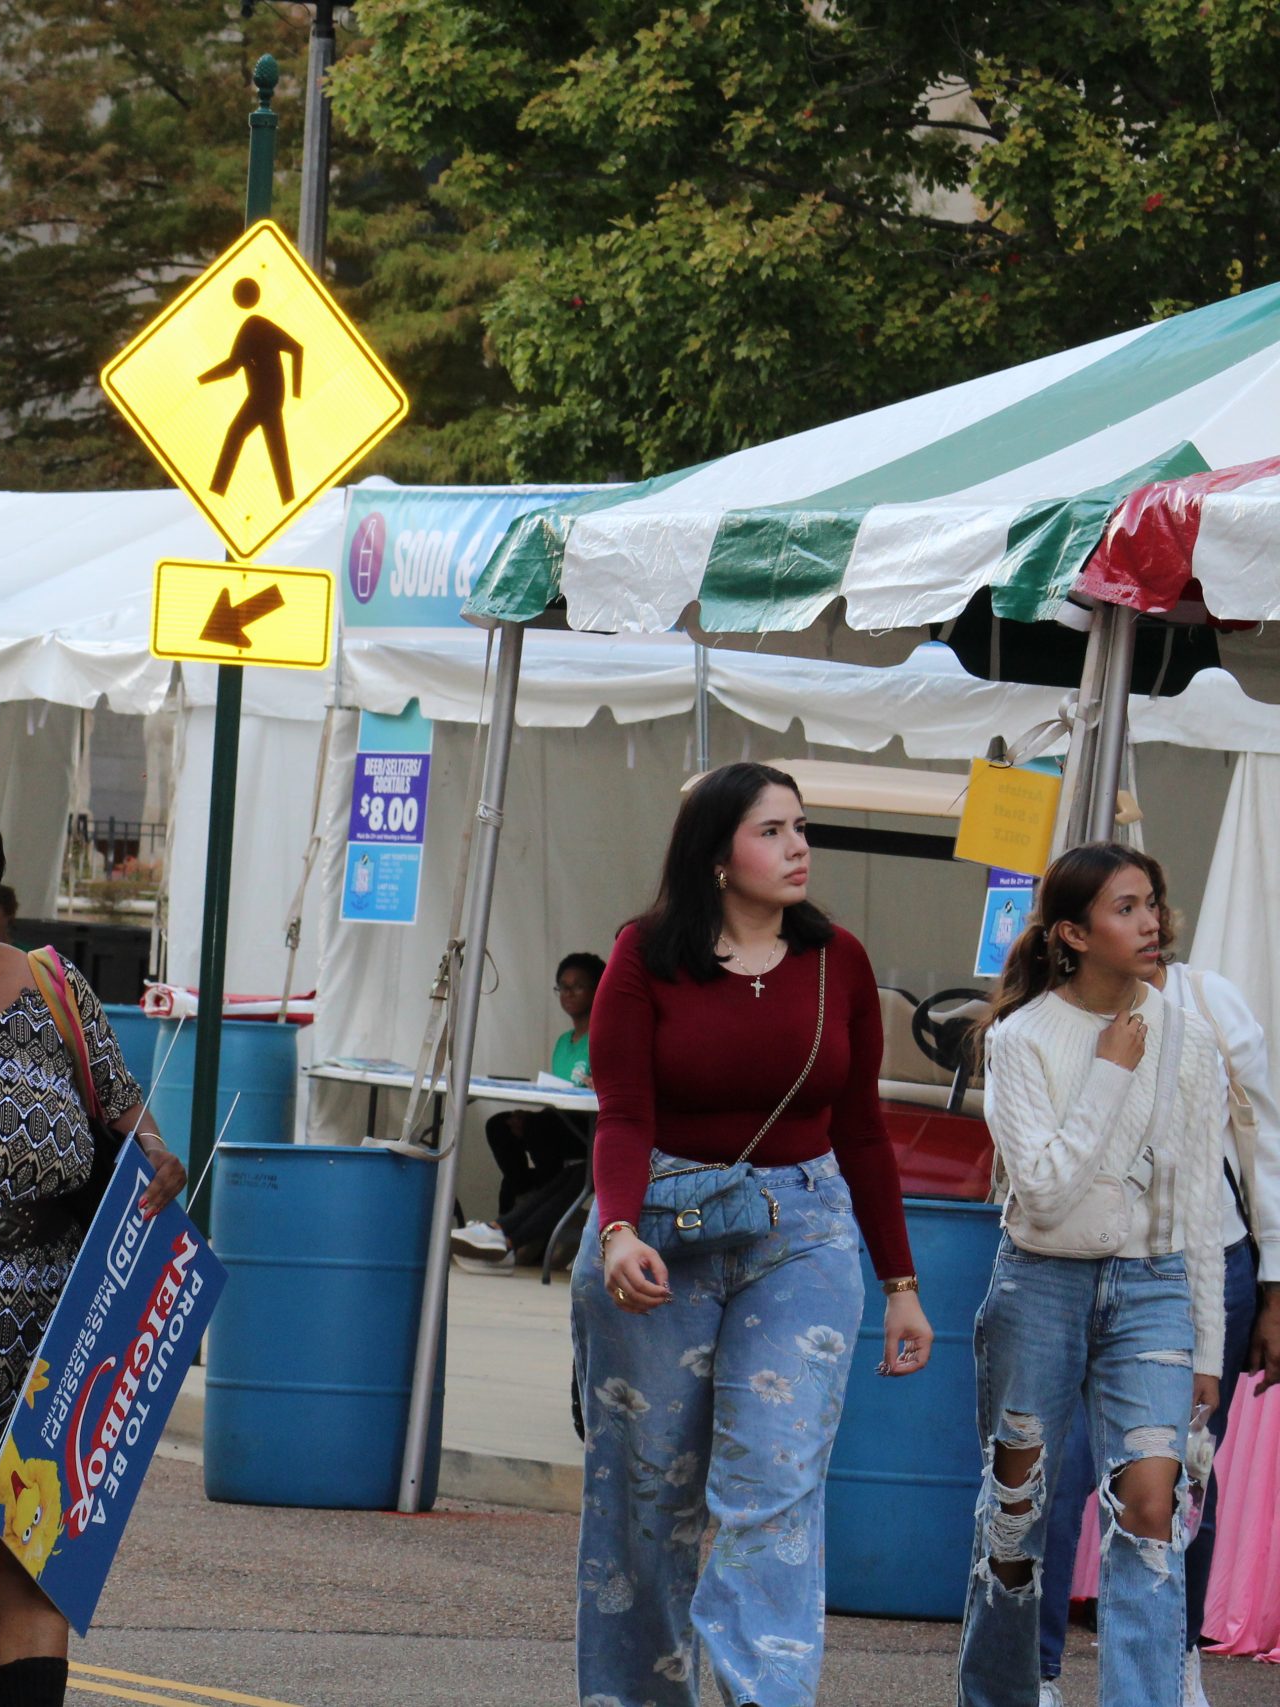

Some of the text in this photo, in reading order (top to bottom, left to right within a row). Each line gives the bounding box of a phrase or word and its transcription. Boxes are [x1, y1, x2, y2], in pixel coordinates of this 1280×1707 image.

[390, 529, 460, 598] SODA
[454, 531, 481, 598] &
[360, 793, 419, 832] $8.00
[373, 775, 412, 794] COCKTAILS
[41, 1275, 108, 1438] PUBLIC BROADCASTING
[45, 1281, 117, 1449] MISSISSIPPI
[70, 1231, 199, 1533] NEIGHBOR
[91, 1269, 204, 1525] PROUD TO BE A
